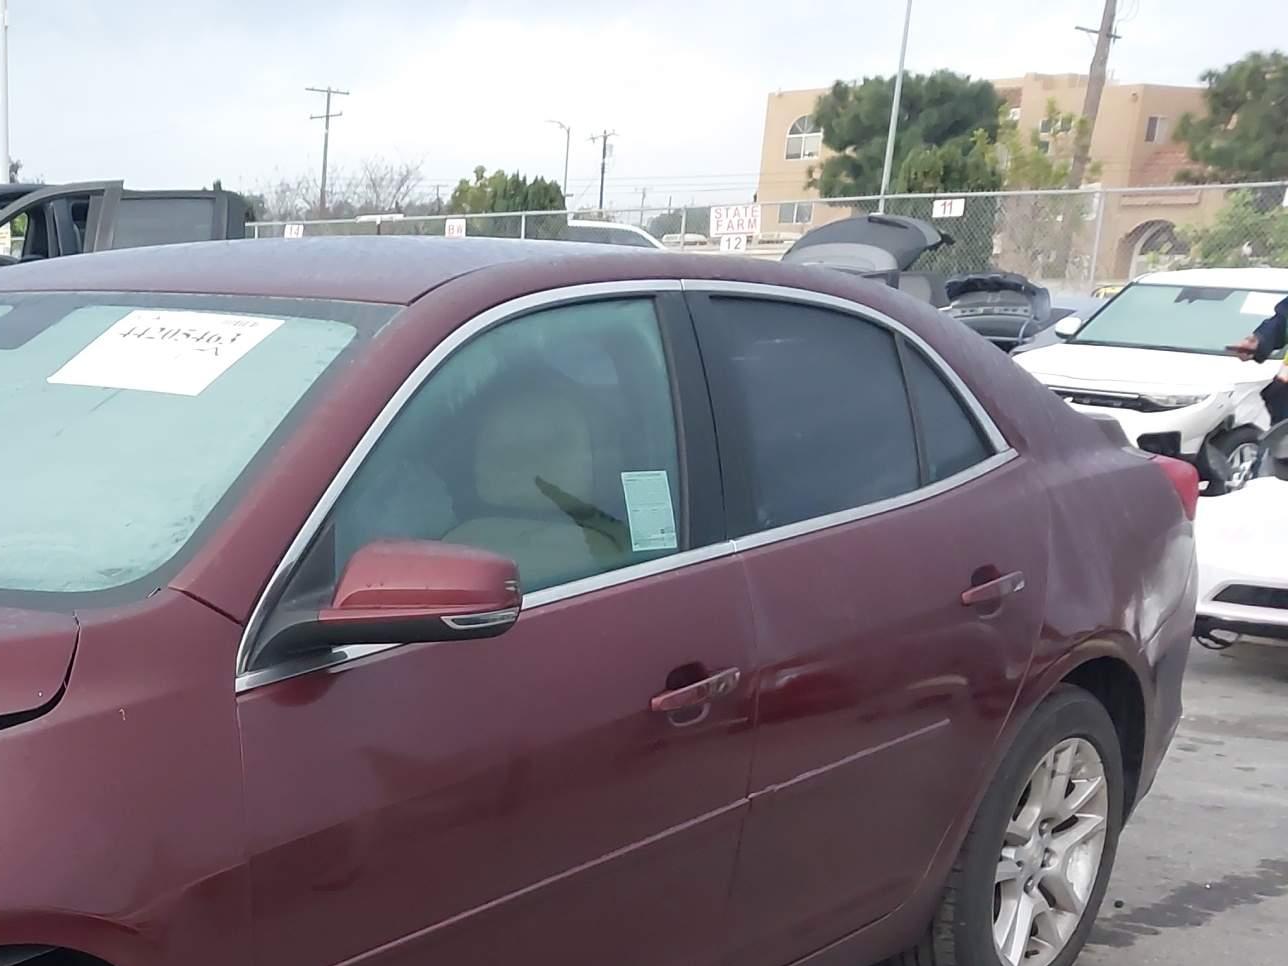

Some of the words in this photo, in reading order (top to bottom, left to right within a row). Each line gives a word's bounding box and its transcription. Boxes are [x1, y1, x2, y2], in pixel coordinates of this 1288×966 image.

[714, 206, 760, 219] STATE
[940, 200, 952, 215] 11
[716, 218, 757, 232] FARM
[725, 236, 743, 250] 12
